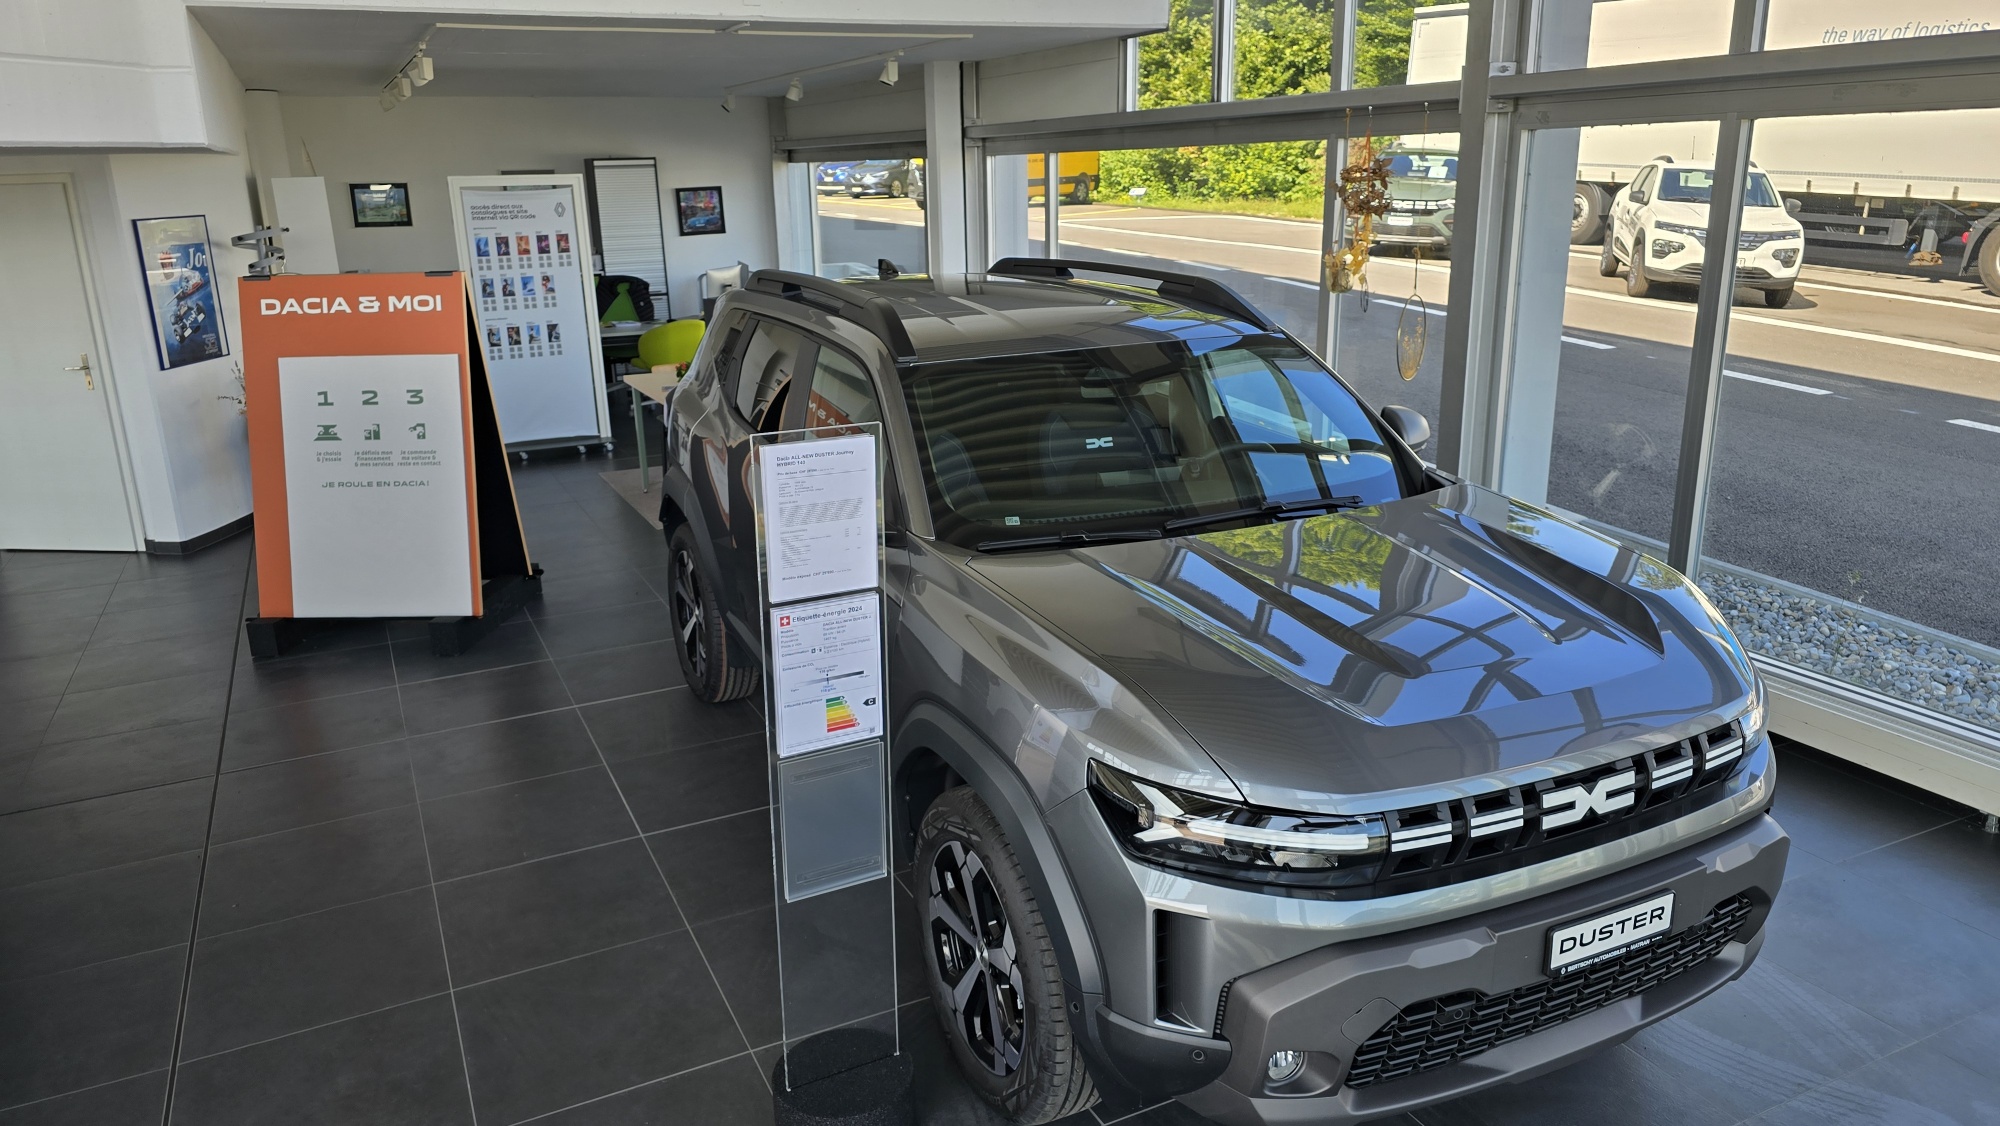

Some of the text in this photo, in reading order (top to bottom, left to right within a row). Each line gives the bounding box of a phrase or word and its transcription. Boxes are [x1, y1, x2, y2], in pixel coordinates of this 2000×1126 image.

[1822, 26, 1847, 44] the
[1852, 27, 1889, 42] way
[1892, 21, 1912, 39] of
[260, 295, 442, 315] DACIA & MOI
[317, 389, 424, 406] 1 2 3
[793, 609, 846, 622] Etiquette-énergie
[1559, 906, 1665, 955] DUSTER
[1594, 948, 1626, 962] AUTOMOBILES
